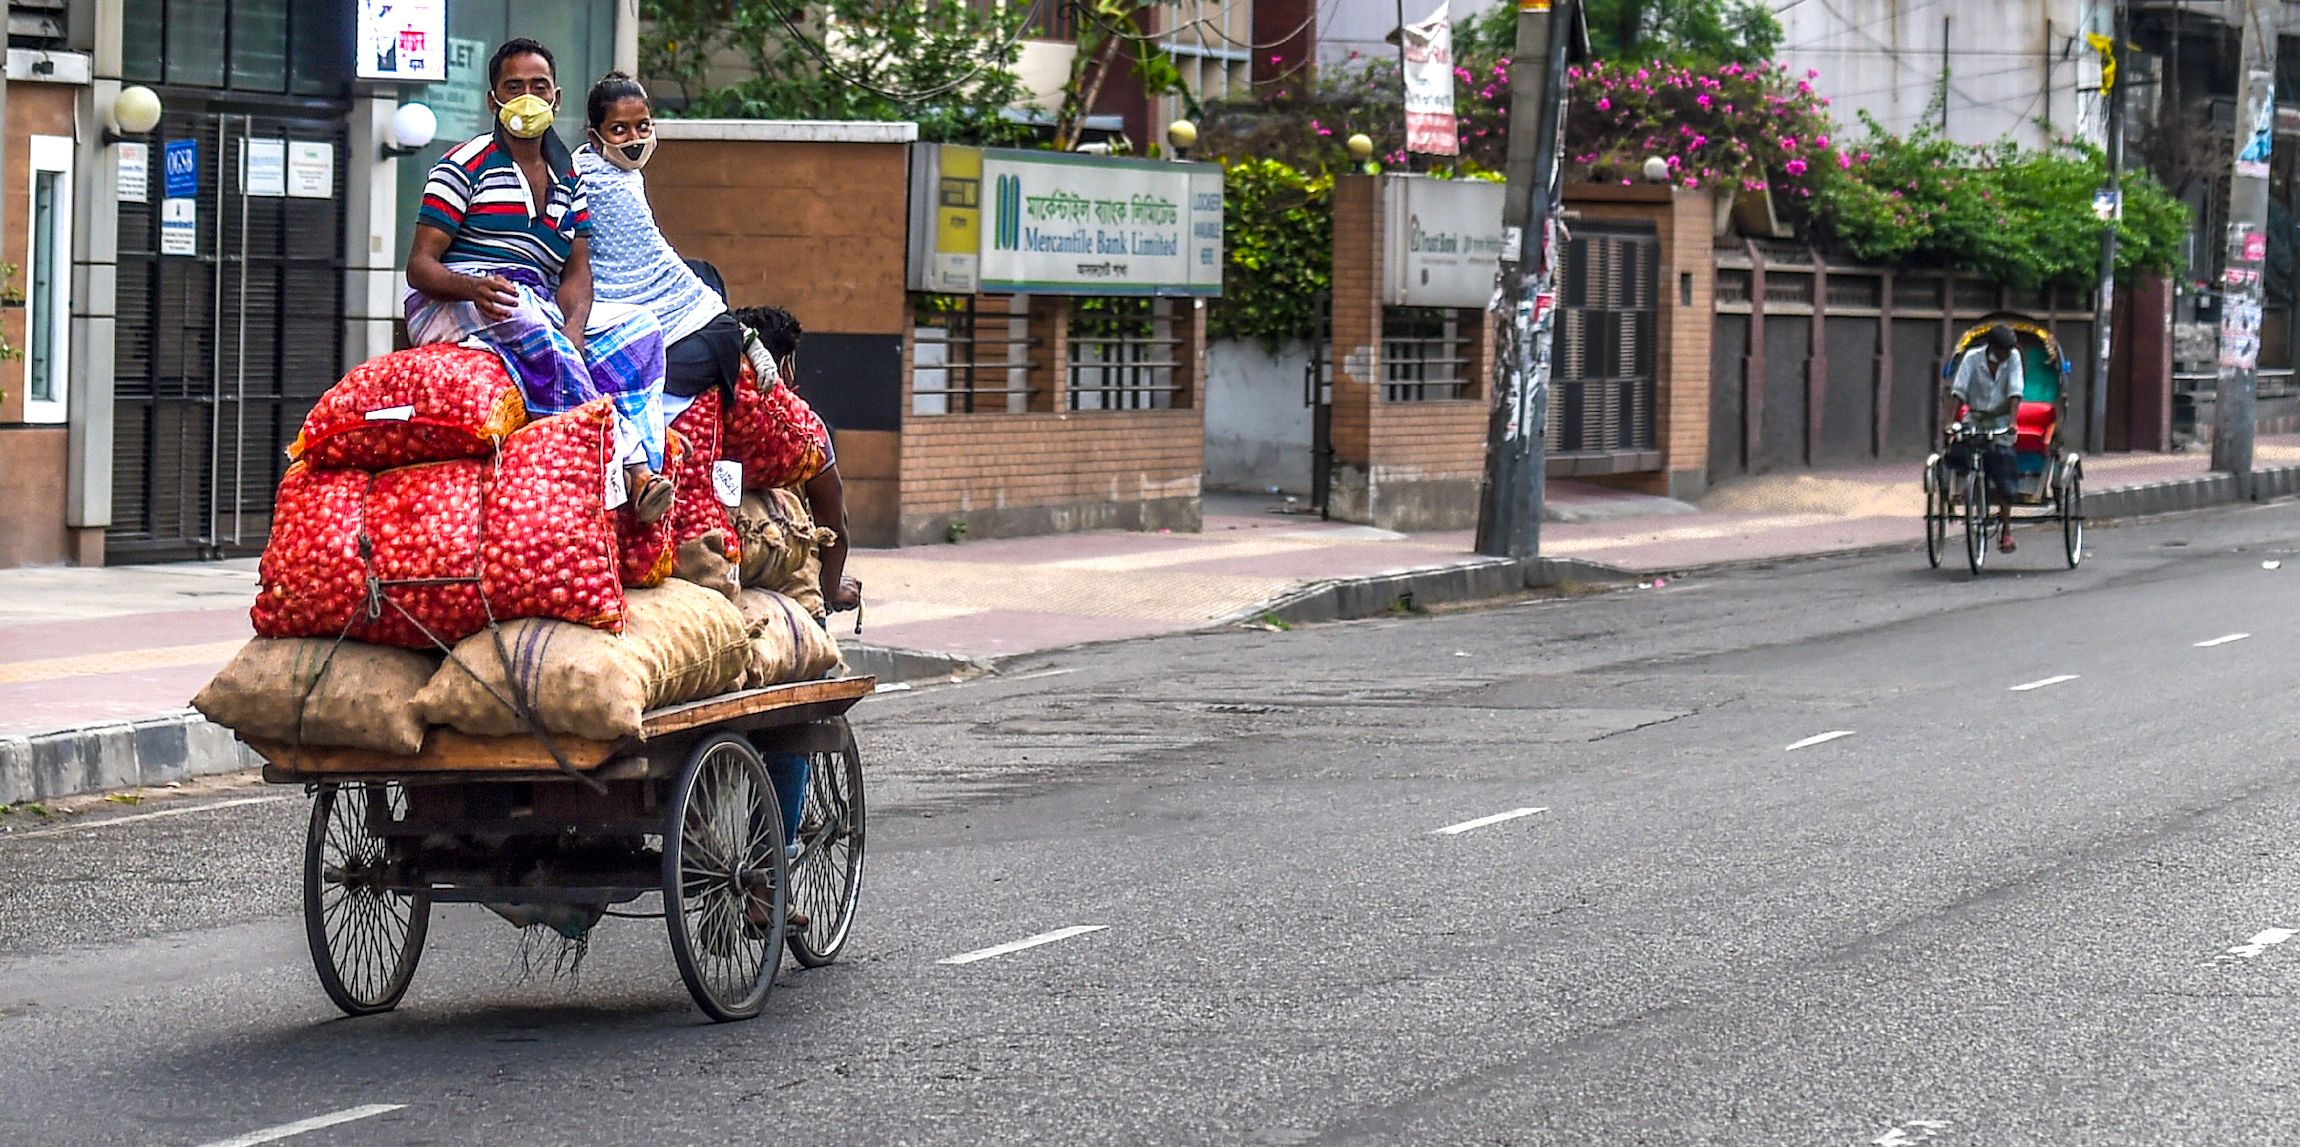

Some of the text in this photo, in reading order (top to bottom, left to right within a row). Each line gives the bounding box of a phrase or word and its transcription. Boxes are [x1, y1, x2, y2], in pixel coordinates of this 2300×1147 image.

[167, 149, 193, 175] OGSB
[1026, 188, 1178, 226] মার্কেন্টাইল ব্যাংক লিমিটেড
[1024, 227, 1178, 256] Mercantile Bank Limited
